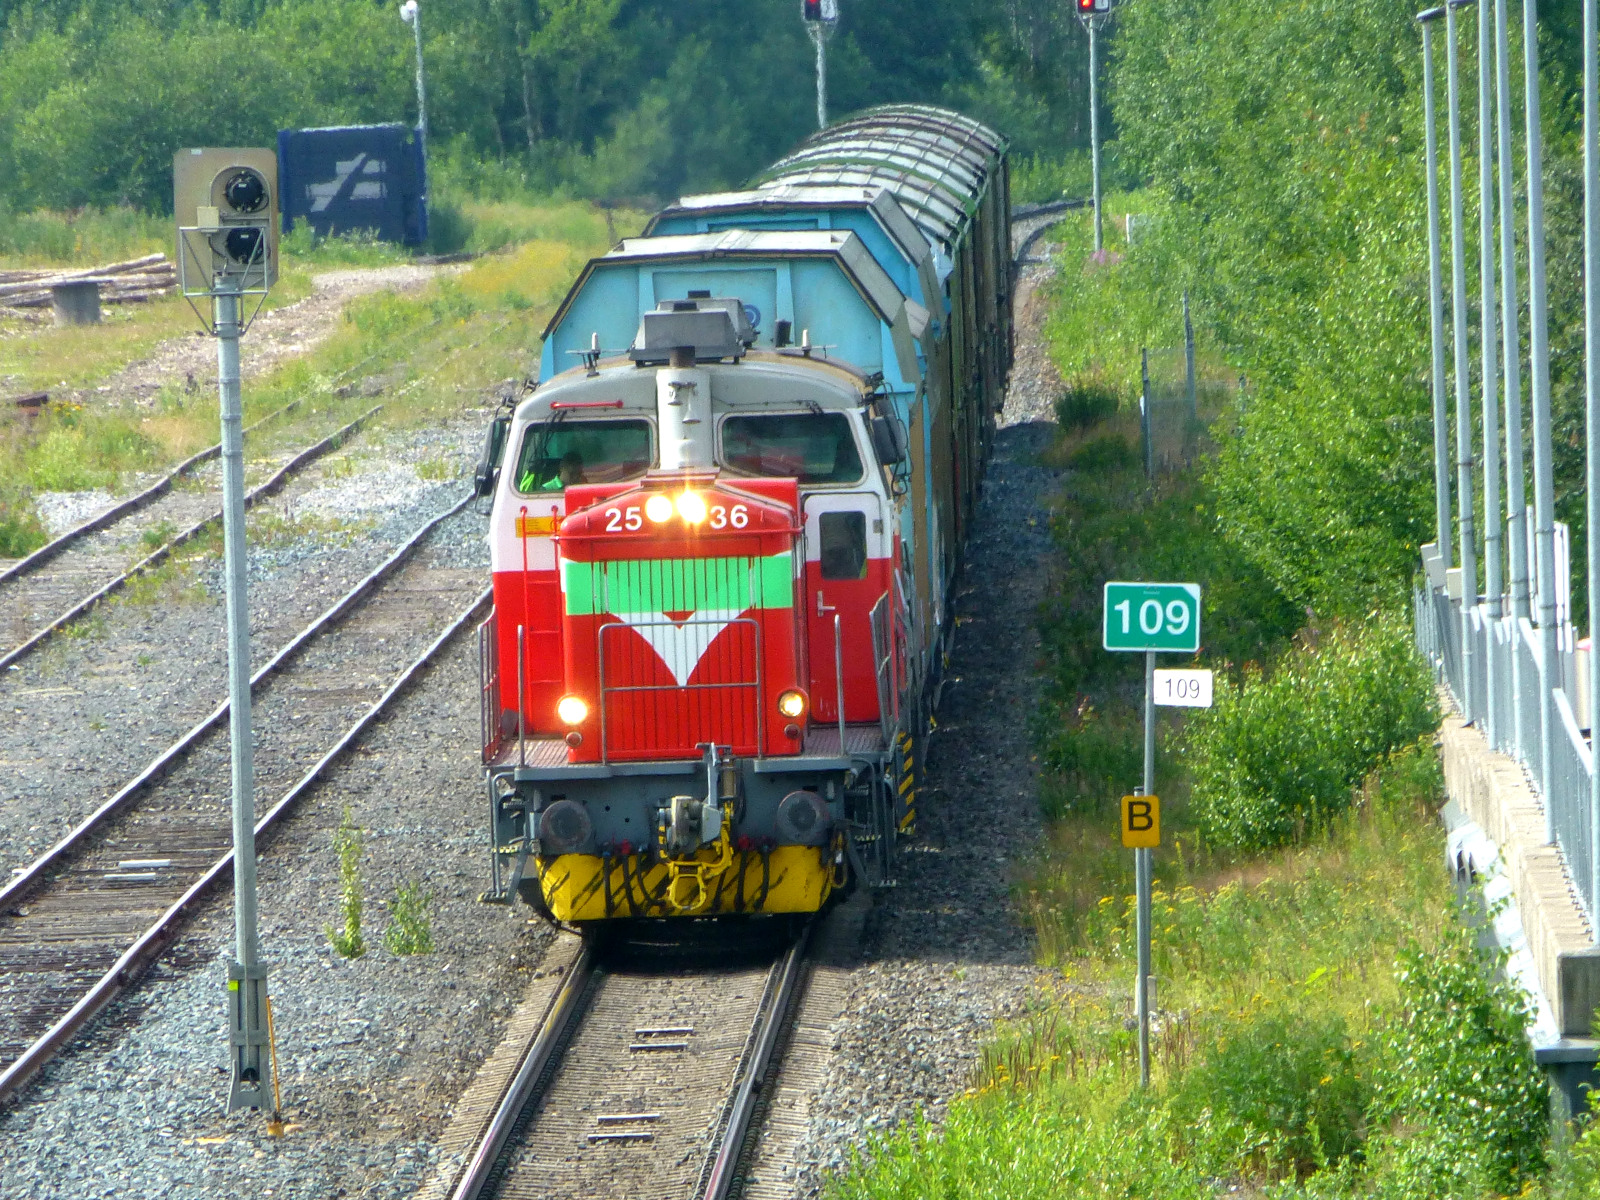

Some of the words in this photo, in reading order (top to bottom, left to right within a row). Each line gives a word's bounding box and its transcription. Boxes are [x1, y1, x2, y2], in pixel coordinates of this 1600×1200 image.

[605, 507, 643, 532] 25
[710, 504, 749, 529] 36
[1114, 599, 1190, 635] 109
[1165, 678, 1200, 699] 109
[1128, 801, 1153, 831] B
